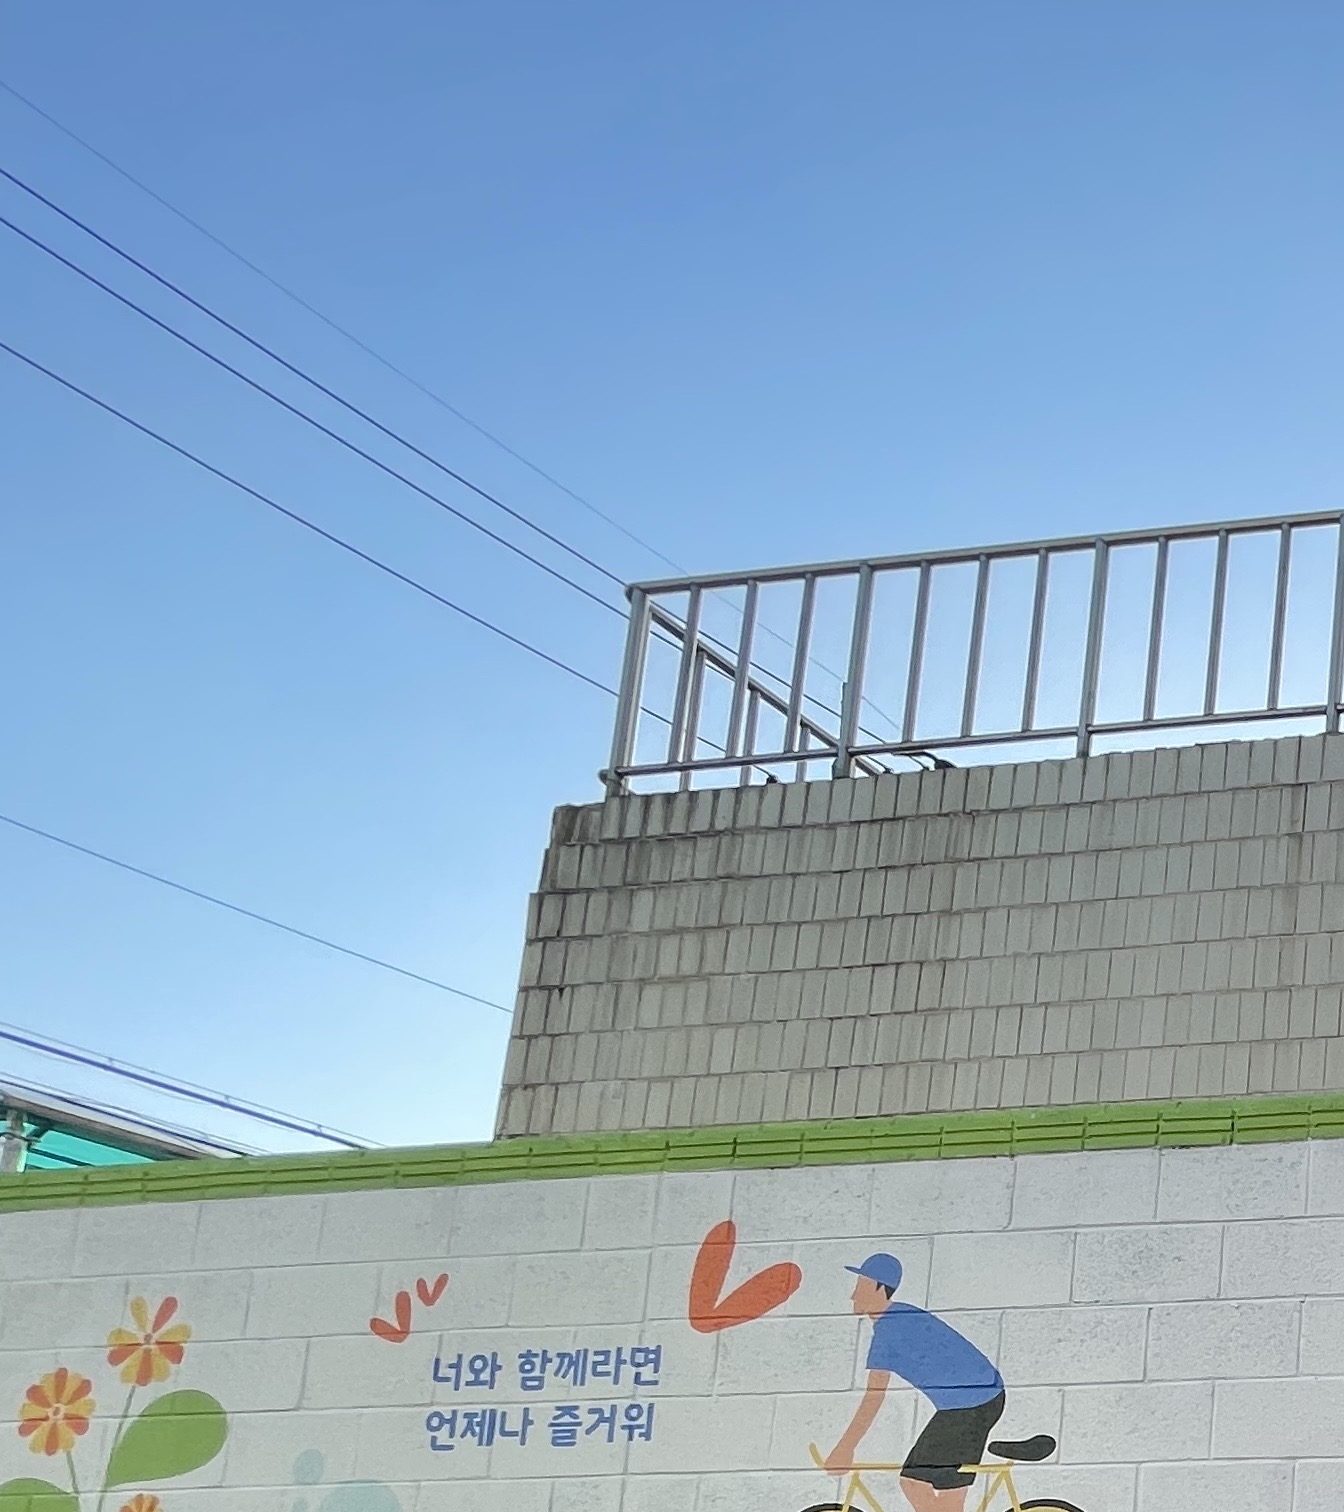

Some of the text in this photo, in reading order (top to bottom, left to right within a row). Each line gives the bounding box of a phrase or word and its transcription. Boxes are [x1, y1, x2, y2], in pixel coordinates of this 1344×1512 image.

[432, 1345, 662, 1391] 너와 함께라면
[425, 1402, 655, 1451] 언제나 즐거워
